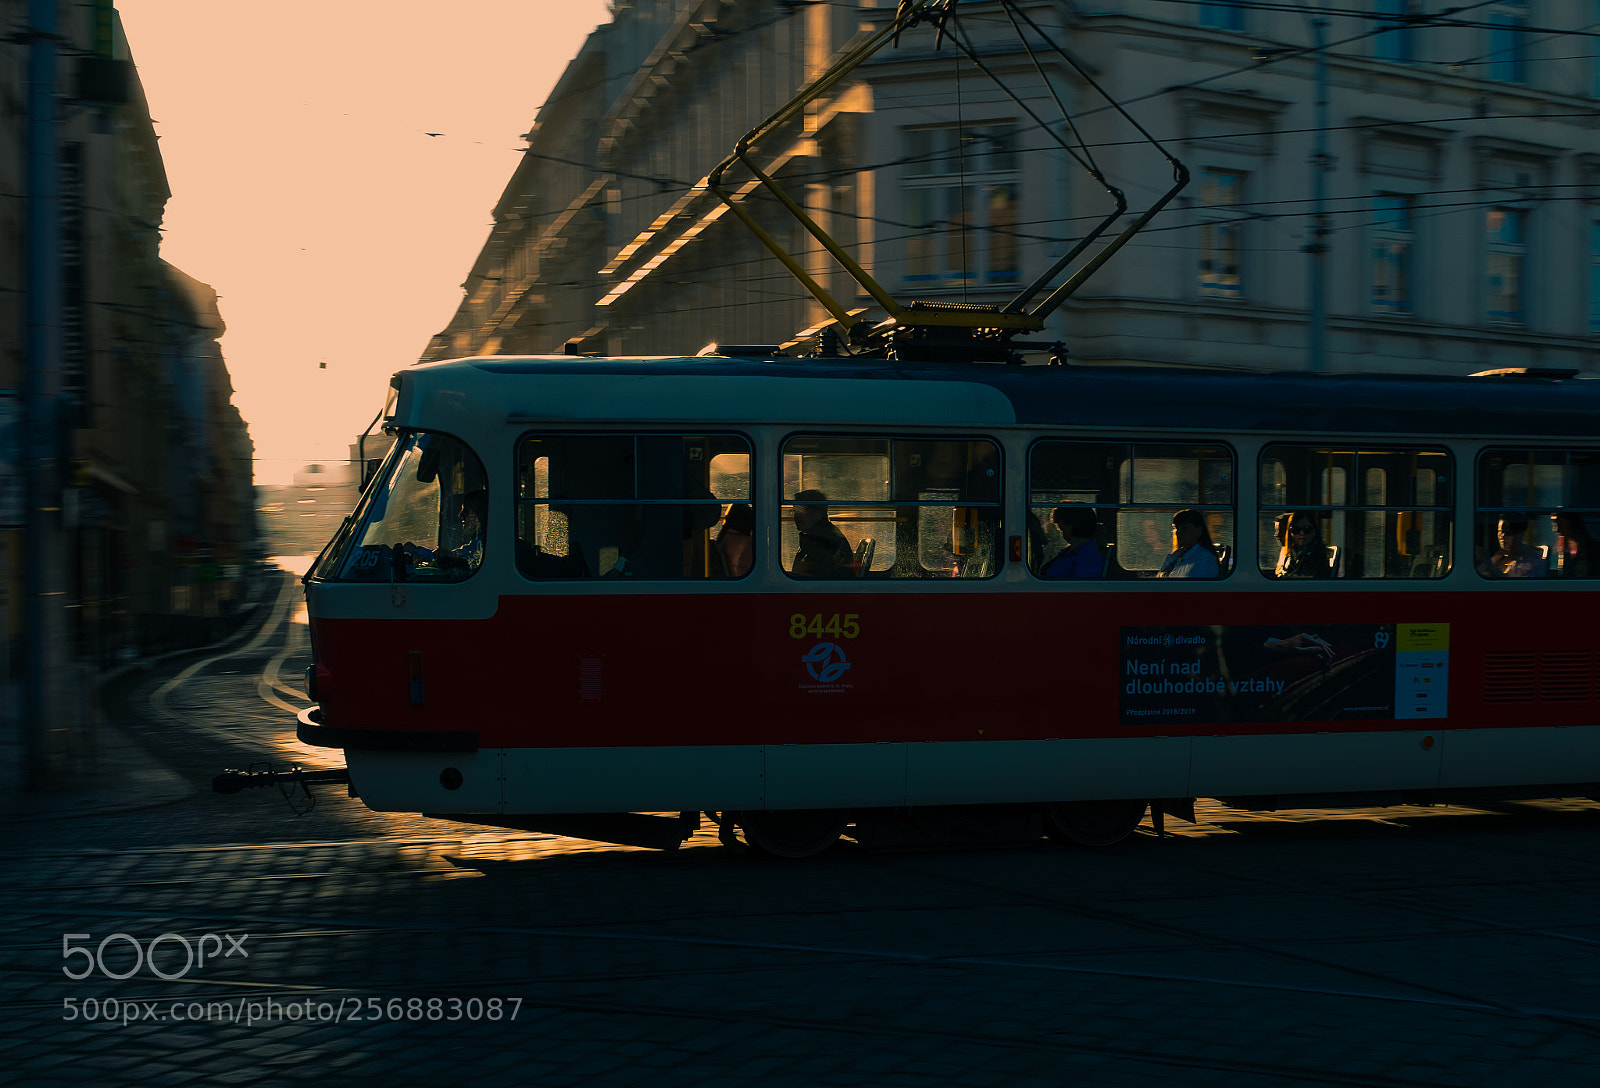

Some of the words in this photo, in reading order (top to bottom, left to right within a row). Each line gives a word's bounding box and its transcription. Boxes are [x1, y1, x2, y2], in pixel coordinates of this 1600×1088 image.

[351, 550, 380, 567] 205
[789, 613, 860, 639] 8445
[1126, 635, 1162, 645] Národní
[1175, 635, 1206, 645] divadlo
[1126, 658, 1166, 676] Není
[1170, 658, 1201, 675] nad
[1126, 677, 1226, 695] dlouhodobé
[1230, 676, 1285, 696] vztahy
